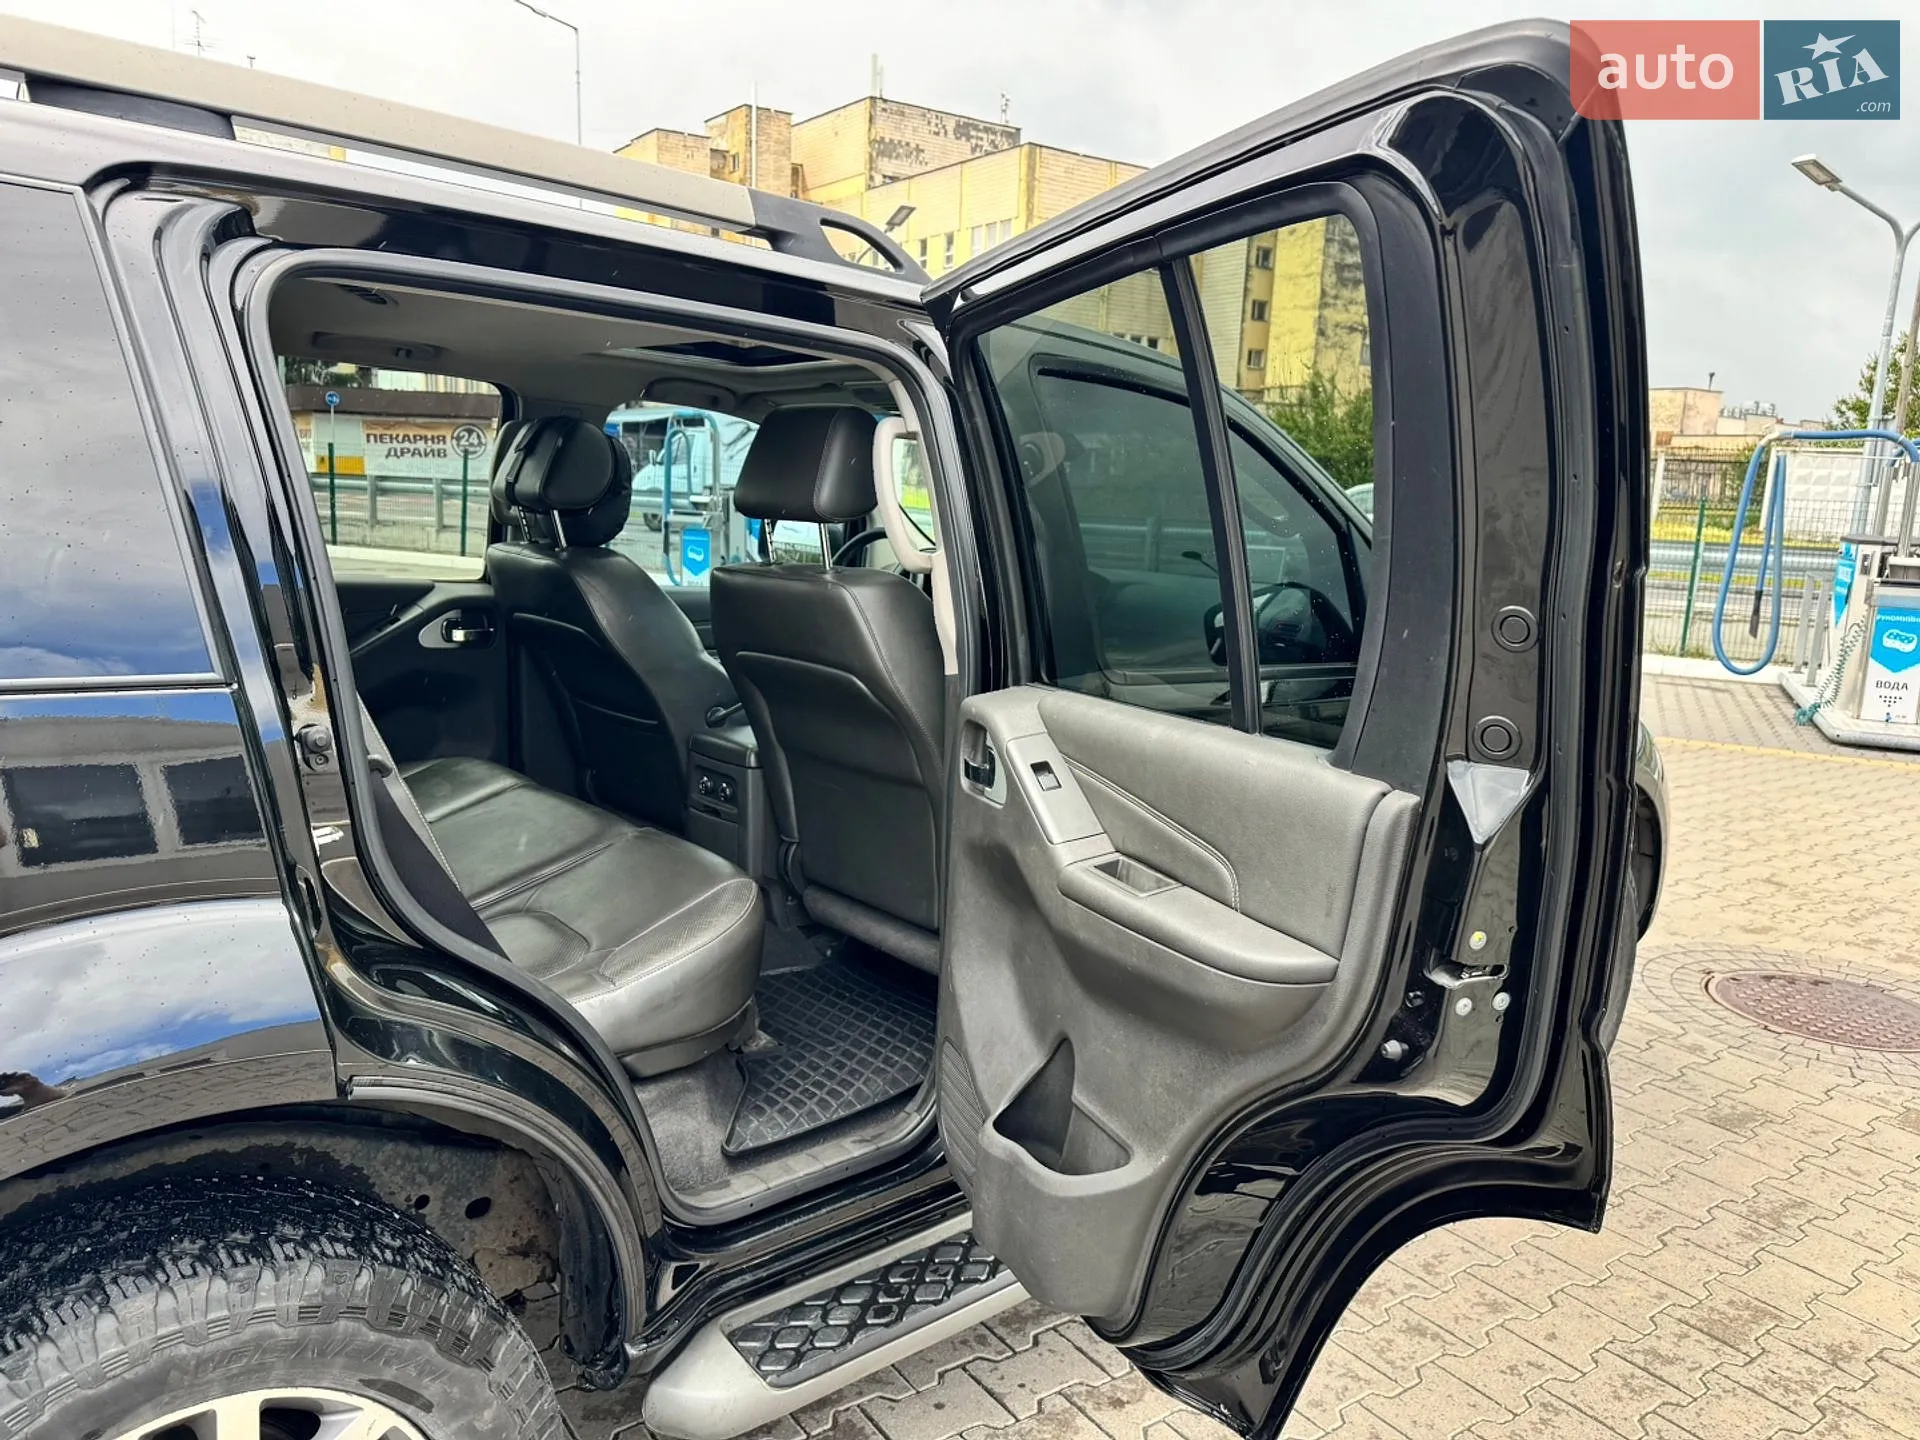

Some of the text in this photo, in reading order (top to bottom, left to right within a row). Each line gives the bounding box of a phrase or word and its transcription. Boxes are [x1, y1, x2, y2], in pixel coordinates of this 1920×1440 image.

[366, 433, 447, 445] ПЕКАРНЯ
[459, 431, 479, 446] 24
[385, 444, 448, 459] ДРАЙВ
[1875, 680, 1908, 691] ВОДА
